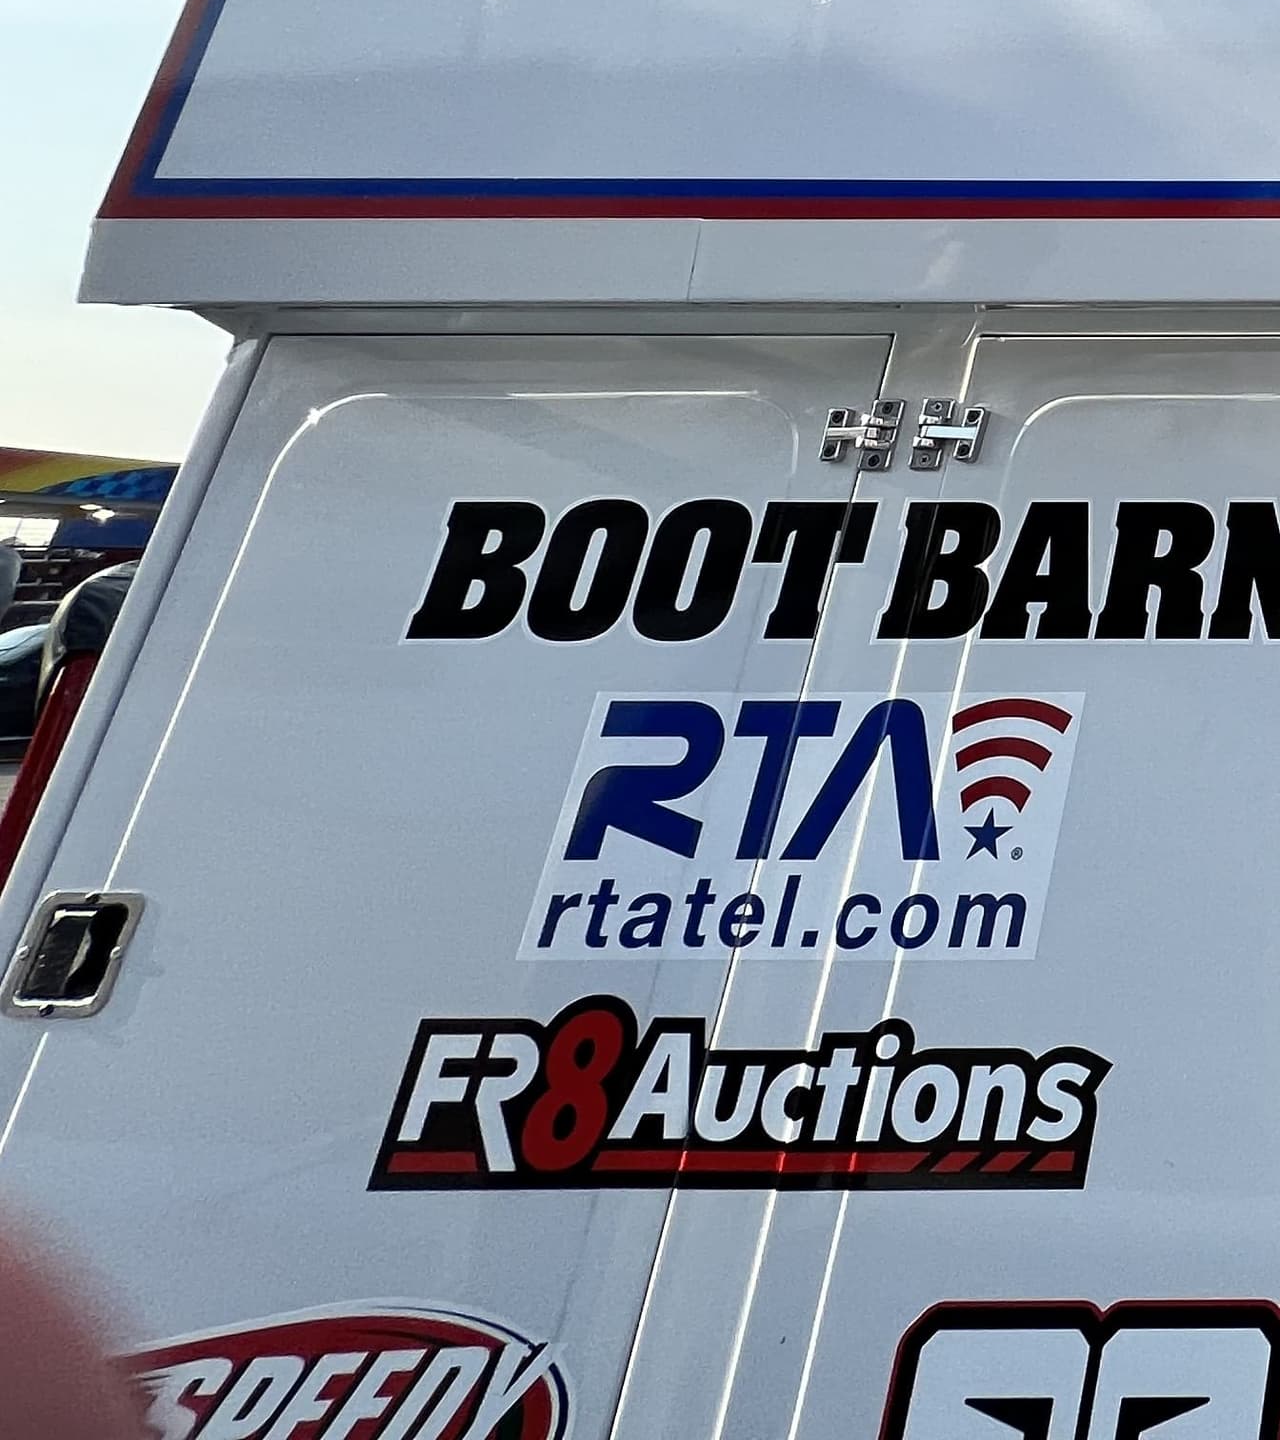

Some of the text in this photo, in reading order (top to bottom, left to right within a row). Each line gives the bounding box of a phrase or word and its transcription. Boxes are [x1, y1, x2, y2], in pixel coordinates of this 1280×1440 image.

[405, 500, 878, 642] BOOT
[563, 698, 941, 861] RTA
[537, 875, 1028, 950] rtatel.com
